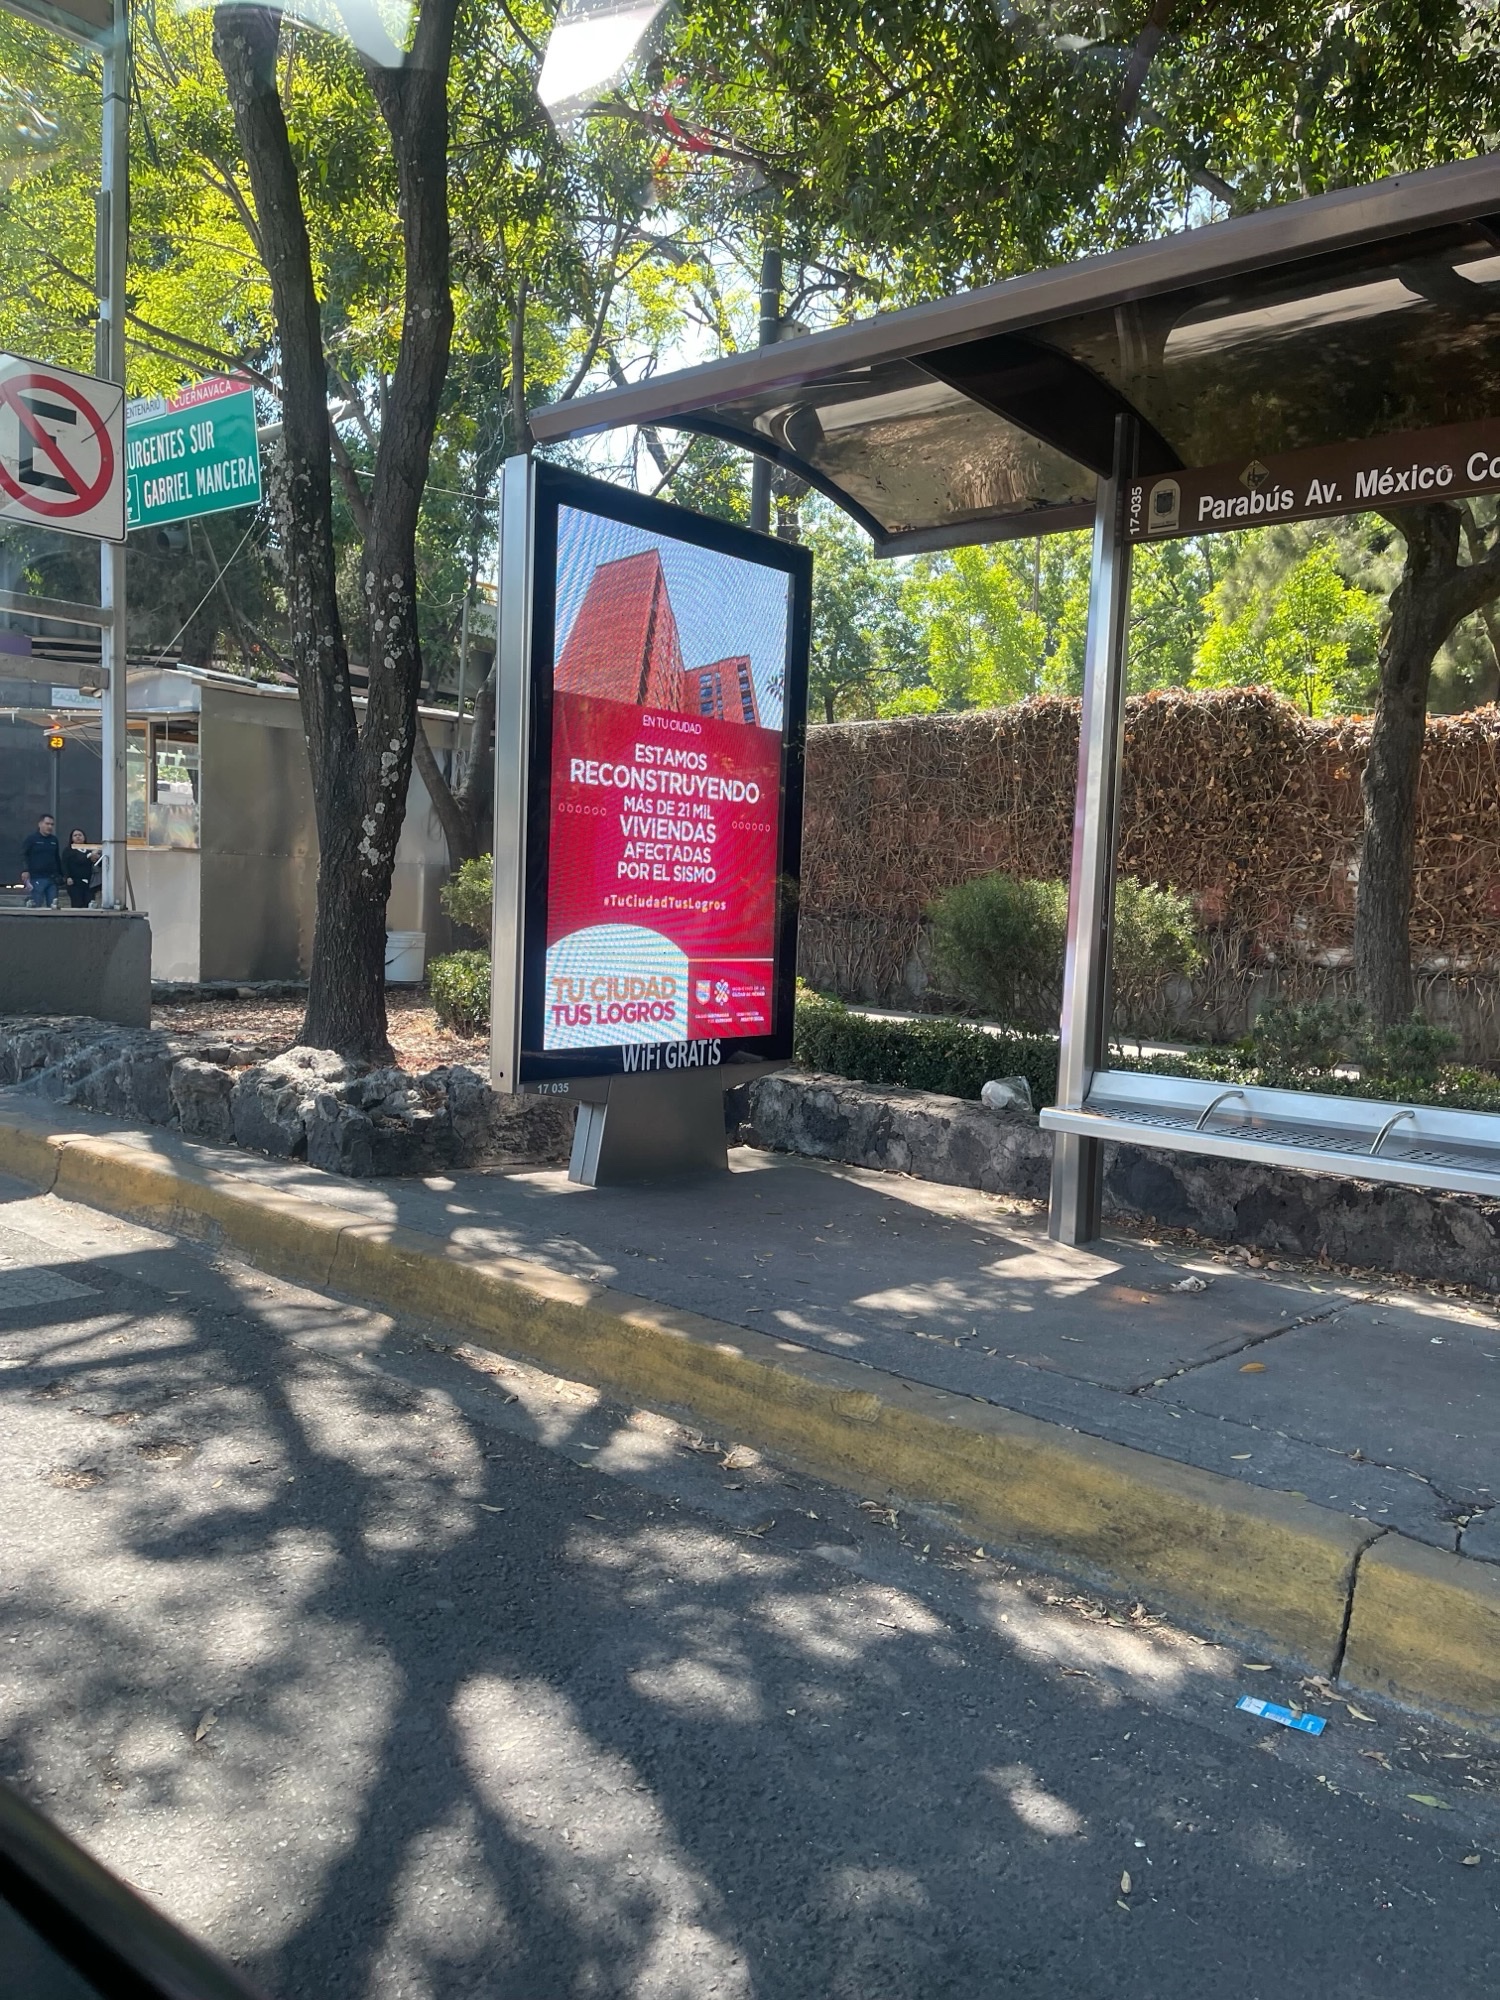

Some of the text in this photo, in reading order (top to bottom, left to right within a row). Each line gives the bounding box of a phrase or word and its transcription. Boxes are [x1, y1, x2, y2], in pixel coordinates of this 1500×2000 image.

[173, 380, 233, 408] CUERNAVACA
[126, 420, 215, 470] URGENTES SUR
[143, 455, 257, 509] GABRIEL MANCERA
[1198, 484, 1294, 522] Parabús
[1305, 478, 1343, 506] Av.
[1354, 464, 1453, 500] México
[1129, 486, 1143, 535] 17-035
[642, 714, 702, 735] EN TU CIUDAD
[50, 737, 63, 748] 23
[635, 743, 708, 771] ESTAMOS
[570, 758, 760, 804] RECONSTRUYENDO
[623, 793, 715, 820] MÁS DE 21 MIL
[619, 814, 717, 844] VIVIENDAS
[623, 841, 712, 863] AFECTADAS
[617, 861, 717, 884] POR EL SISMO
[603, 894, 727, 913] #TuCiudadTusLogros
[551, 976, 677, 1003] TU CIUDAD
[551, 1004, 592, 1028] TUS
[596, 1001, 676, 1025] LOGROS
[621, 1041, 661, 1073] WiFi
[537, 1083, 569, 1094] 17 035
